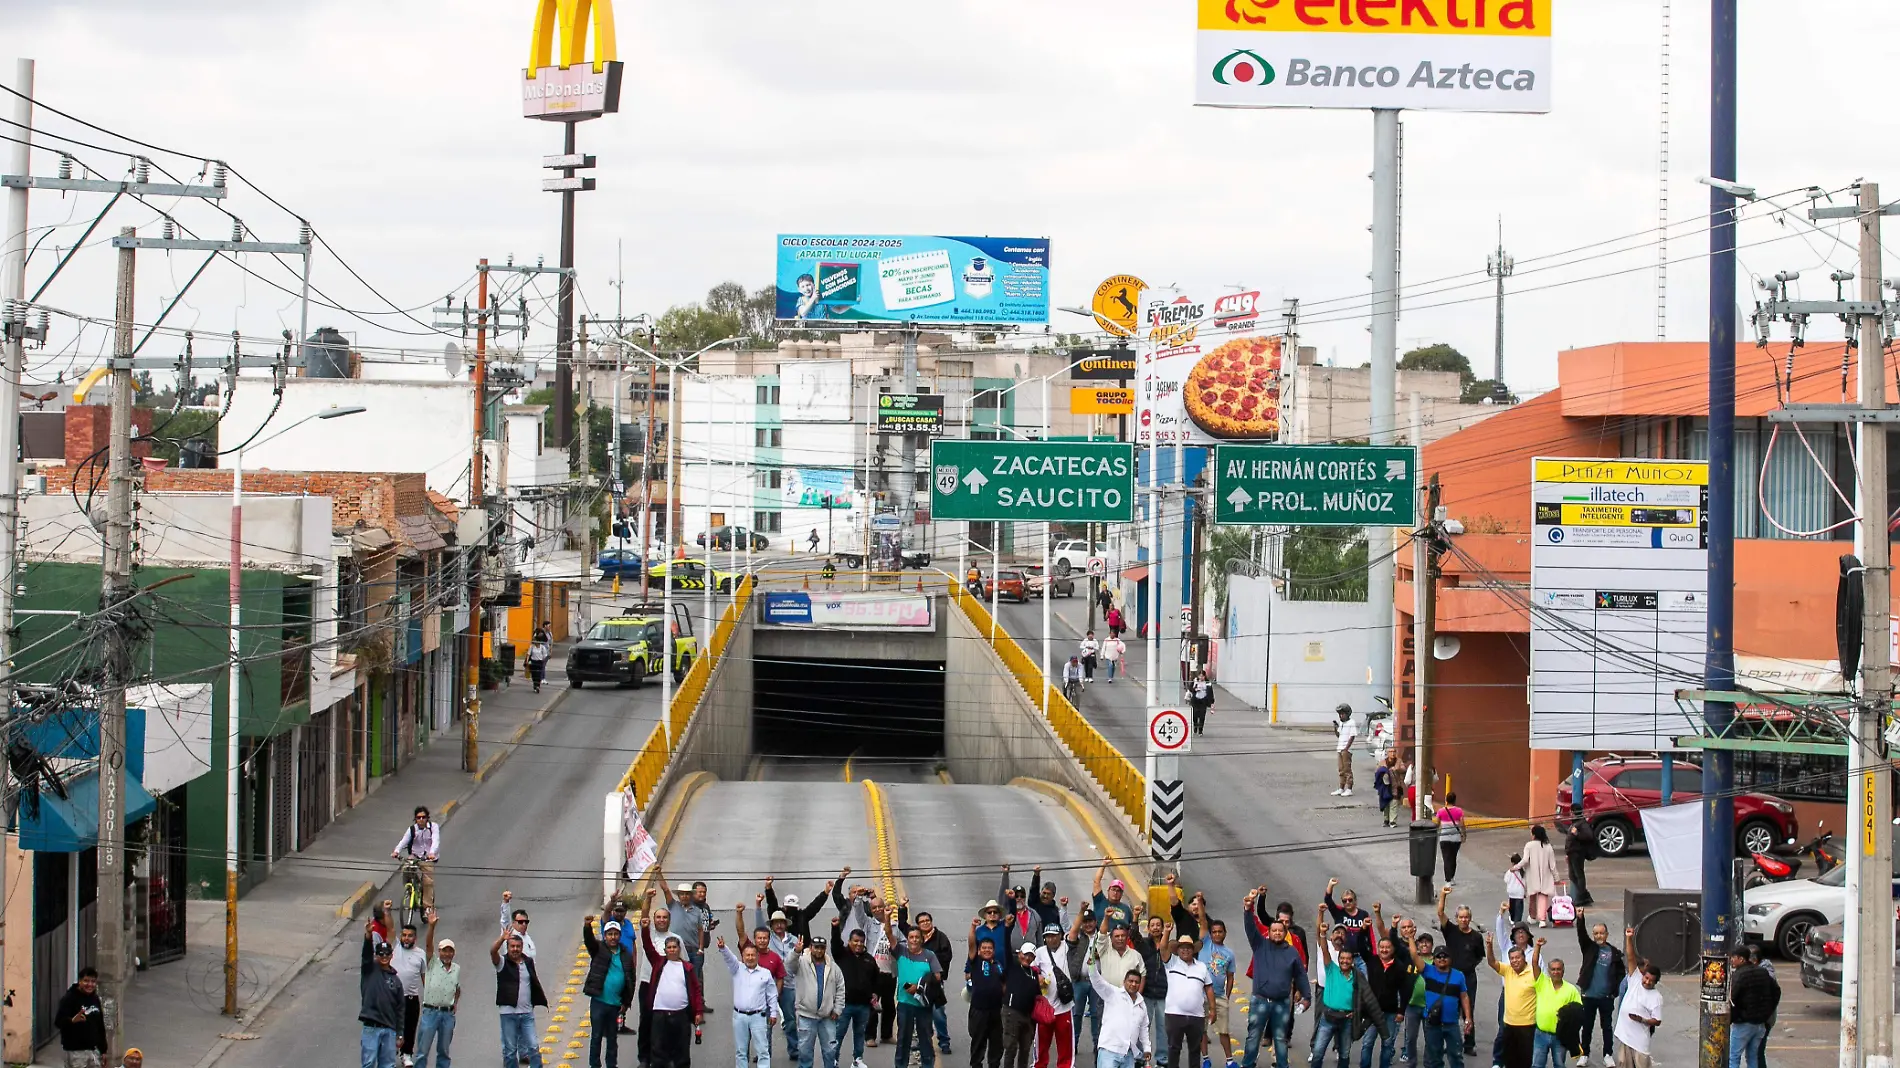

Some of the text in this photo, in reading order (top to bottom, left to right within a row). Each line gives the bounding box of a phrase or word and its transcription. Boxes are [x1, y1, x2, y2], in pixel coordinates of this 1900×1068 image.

[1285, 58, 1536, 91] Banco Azteca
[524, 81, 604, 100] McDonald's
[782, 238, 902, 248] CICLO ESCOLAR 2024-2025
[836, 250, 847, 258] TU
[850, 251, 882, 259] LUGAR!
[820, 268, 848, 285] VOLVEMOS
[882, 268, 901, 278] 20%
[911, 264, 949, 273] INSCRIPCIONES
[821, 277, 857, 298] PROMOCIONES
[825, 280, 837, 290] CON
[905, 284, 932, 295] BECAS
[912, 292, 942, 301] HERMANOS
[1146, 304, 1205, 326] EXTREMAS
[1228, 320, 1256, 331] GRANDE
[1156, 381, 1178, 391] ACEMOS
[885, 416, 915, 424] ¿BUSCAS
[894, 423, 943, 432] 813.55.51
[992, 455, 1127, 477] ZACATECAS
[1226, 457, 1377, 481] AV. HERNÁN CORTÉS
[939, 476, 956, 488] 49
[997, 487, 1121, 508] SAUCITO
[1258, 489, 1394, 512] PROL. MUÑOZ
[1590, 486, 1644, 502] illatech
[844, 602, 913, 617] 96.9 FM
[1739, 669, 1782, 678] LAZA
[1342, 916, 1364, 928] POLO
